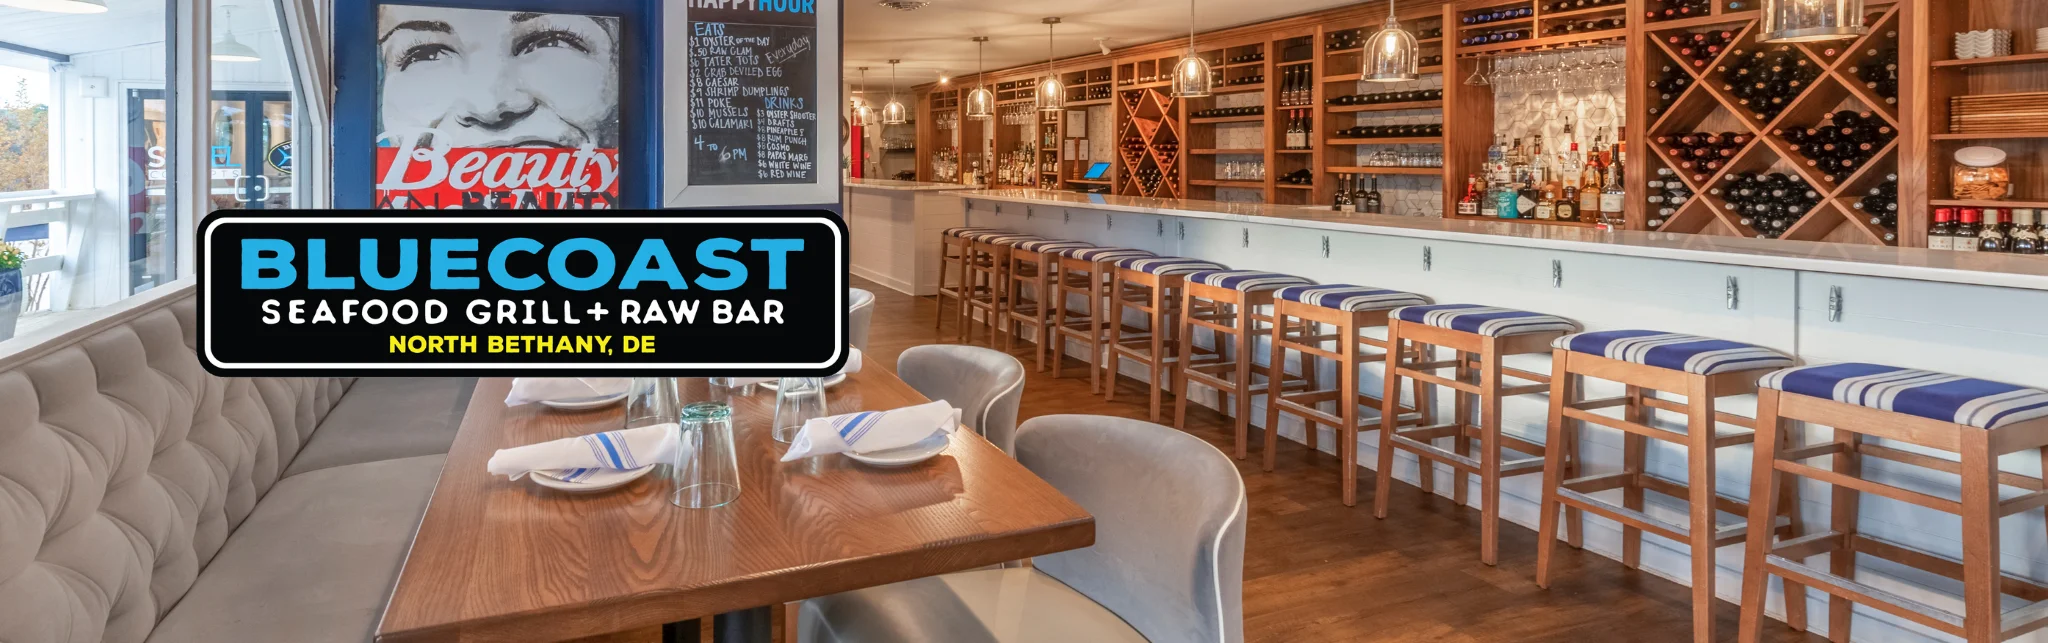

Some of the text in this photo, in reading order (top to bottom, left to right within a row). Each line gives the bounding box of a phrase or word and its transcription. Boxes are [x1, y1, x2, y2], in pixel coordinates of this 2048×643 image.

[694, 22, 725, 36] EATS
[689, 36, 700, 48] $1
[703, 36, 735, 47] OYSTER
[756, 36, 770, 46] DAY
[689, 47, 752, 57] $.50 RAW CLAM
[764, 36, 811, 64] Everyday
[689, 55, 759, 67] $6 TATER TOTS
[690, 66, 782, 78] $2 CRAB DEVILED EGG
[705, 78, 739, 88] CAESAR
[705, 86, 739, 97] SHRIMP
[742, 86, 789, 97] DUMPLINGS
[690, 97, 732, 109] $11 POKE
[764, 97, 804, 110] DRINKS
[690, 107, 748, 119] $10 MUSSELS
[757, 108, 816, 121] $3 OYSTER SHOOTER
[692, 118, 753, 130] $10 CALAMARI
[767, 118, 795, 128] DRAFTS
[766, 126, 798, 136] PINEAPPLE
[767, 134, 782, 143] RUM
[784, 136, 807, 146] PUNCH
[694, 134, 747, 161] 4 TO 6 PM
[766, 142, 790, 152] COSMO
[376, 127, 618, 194] Beauty
[767, 150, 786, 160] PAPAS
[788, 152, 808, 161] MARG
[757, 160, 812, 170] $6 WHITE WINE
[757, 169, 806, 179] $6 RED WINE
